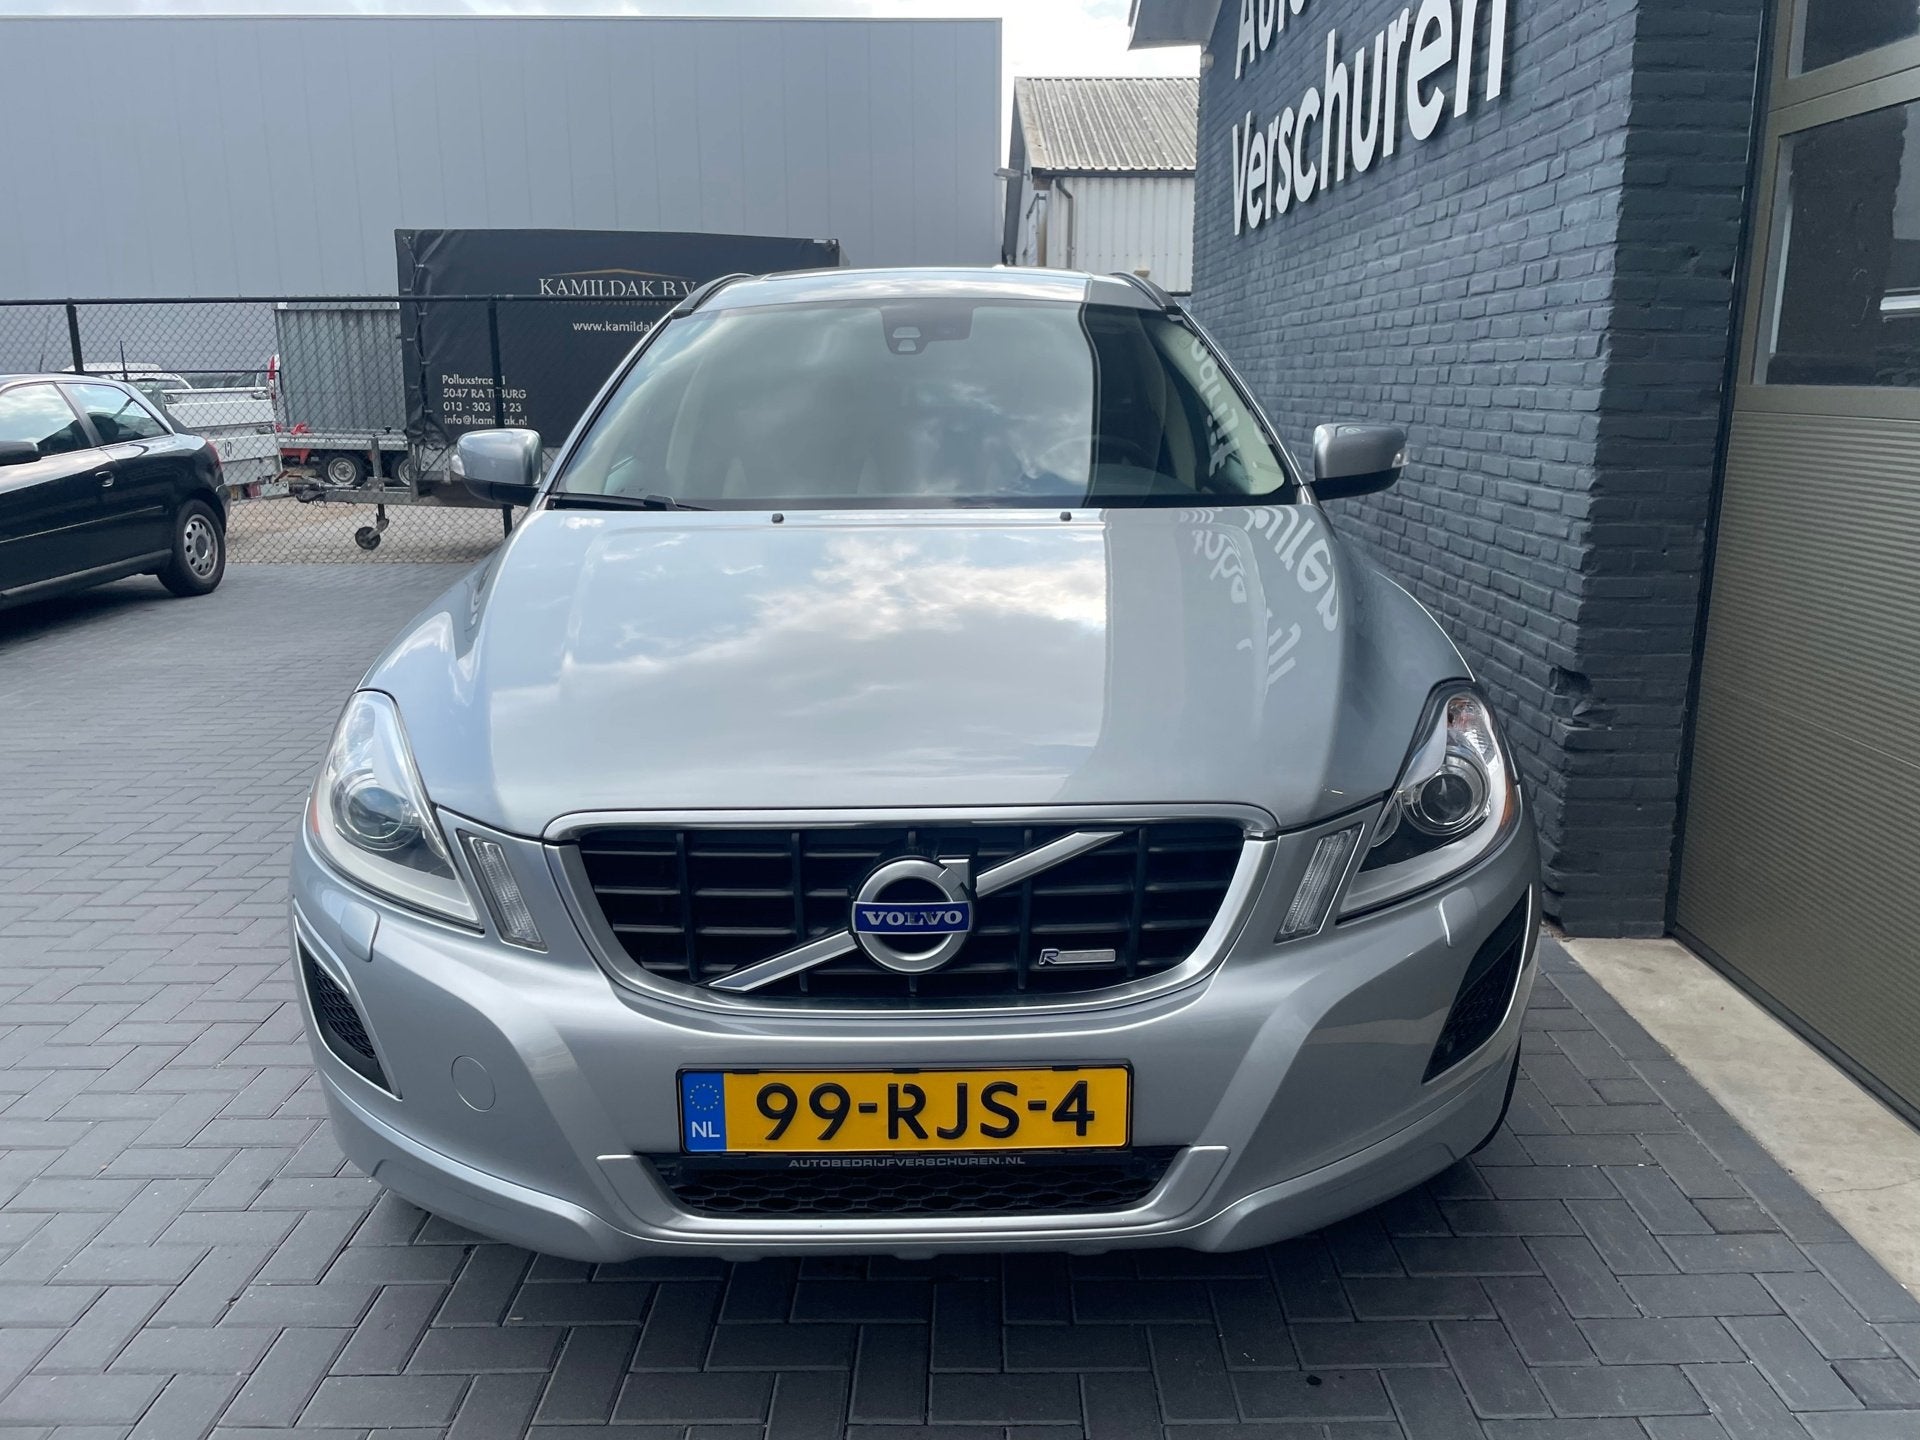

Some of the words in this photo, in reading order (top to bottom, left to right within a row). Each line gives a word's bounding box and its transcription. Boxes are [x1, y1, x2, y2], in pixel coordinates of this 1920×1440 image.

[1235, 0, 1305, 80] Au
[1232, 0, 1506, 236] Verschuren
[539, 278, 655, 297] KAMILDAK
[442, 374, 494, 385] Polluxstraa
[443, 388, 468, 398] 5047
[471, 389, 485, 398] RA
[487, 389, 527, 399] TIBURG
[443, 401, 463, 411] 013
[472, 402, 491, 412] 303
[510, 403, 522, 412] 23
[444, 414, 527, 425] info@kamiak.nl
[862, 910, 963, 926] VOLVO
[756, 1080, 1095, 1141] 99-RJS-4
[691, 1121, 721, 1138] NL
[789, 1157, 1025, 1168] AUTOBEDRIJFVERSCHUREN.NL
